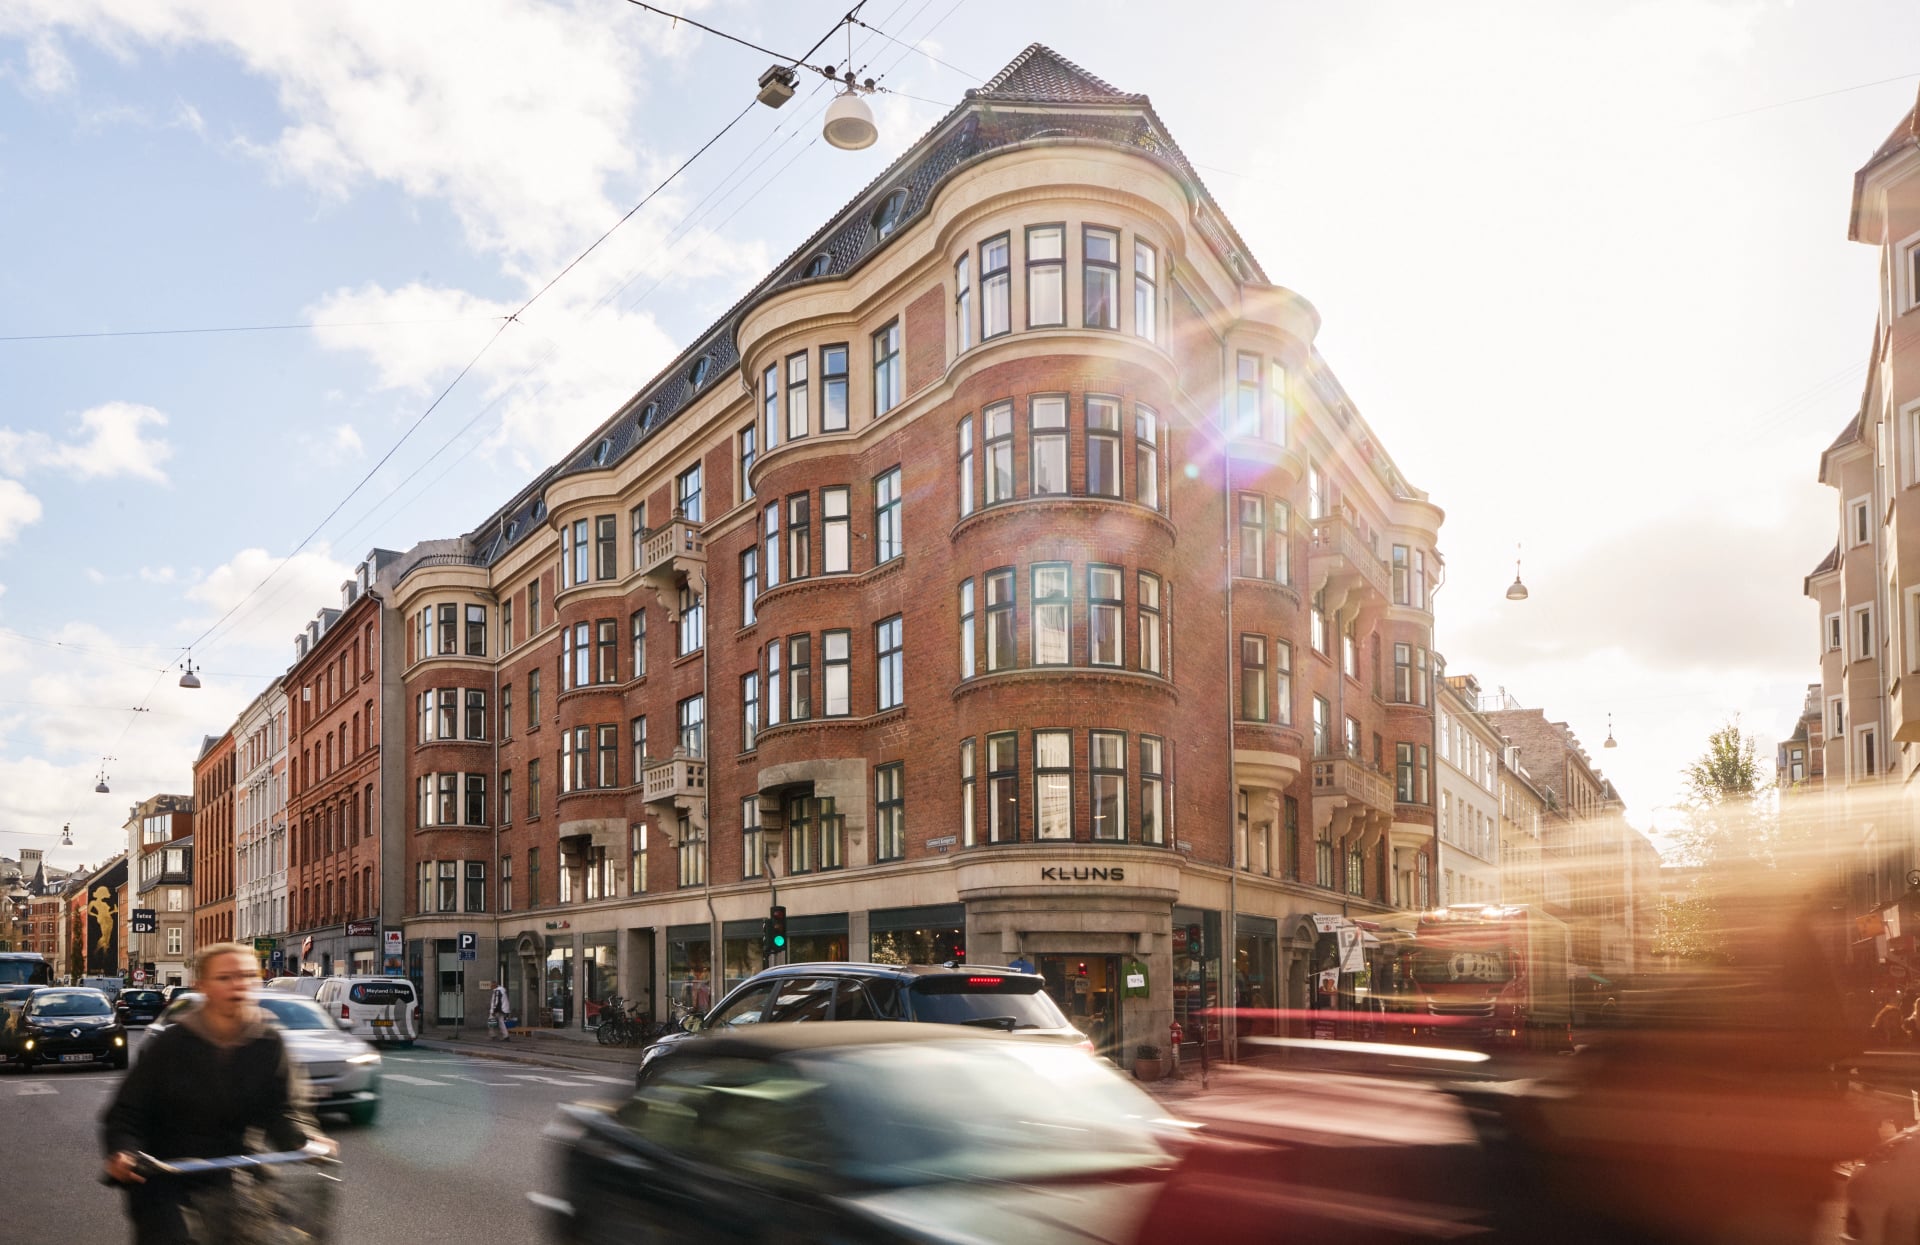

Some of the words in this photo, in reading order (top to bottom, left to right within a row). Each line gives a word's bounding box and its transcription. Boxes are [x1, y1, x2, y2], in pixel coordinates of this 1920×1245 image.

[1041, 866, 1124, 881] KLUNS
[462, 934, 473, 949] P
[273, 951, 281, 961] P
